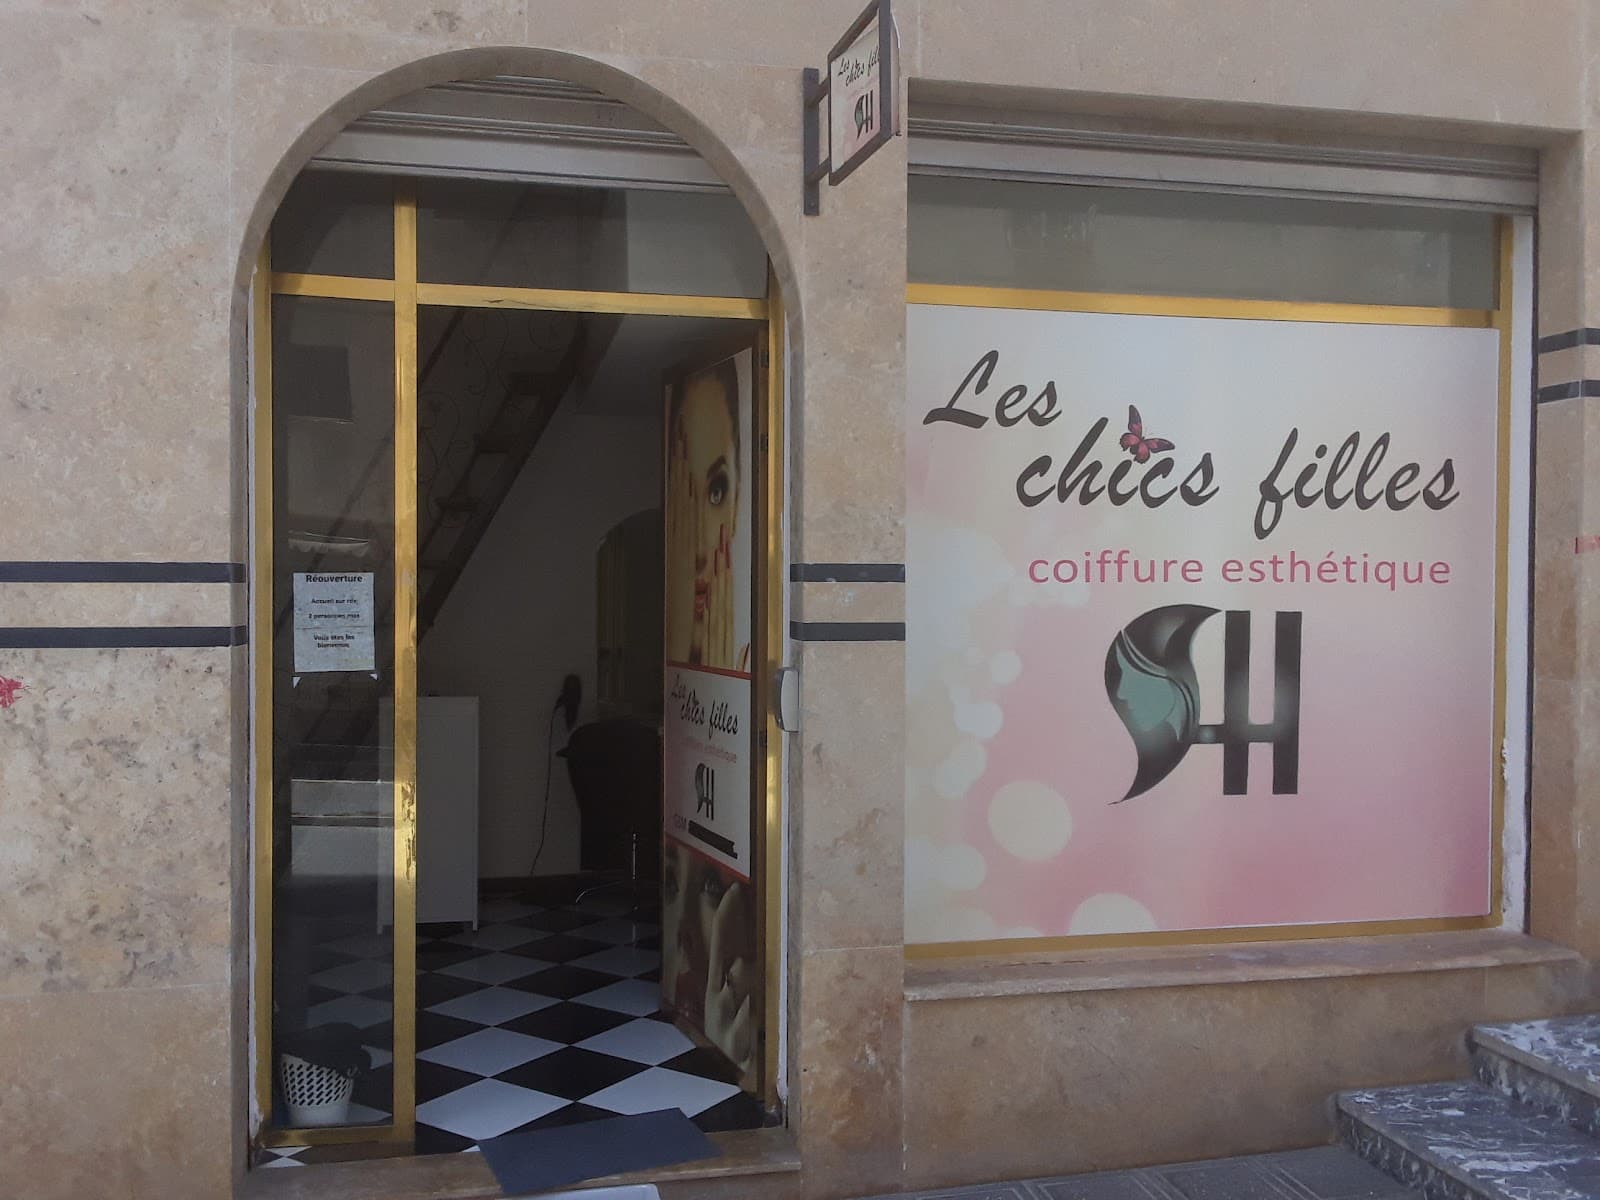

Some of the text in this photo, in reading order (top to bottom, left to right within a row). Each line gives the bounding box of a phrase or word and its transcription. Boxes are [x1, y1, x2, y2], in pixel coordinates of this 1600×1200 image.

[837, 57, 850, 77] Les
[922, 349, 1063, 429] Les
[1015, 415, 1461, 540] chics filles
[305, 574, 363, 583] Réouverture
[1028, 549, 1451, 592] coiffure esthétique
[709, 699, 739, 741] filles
